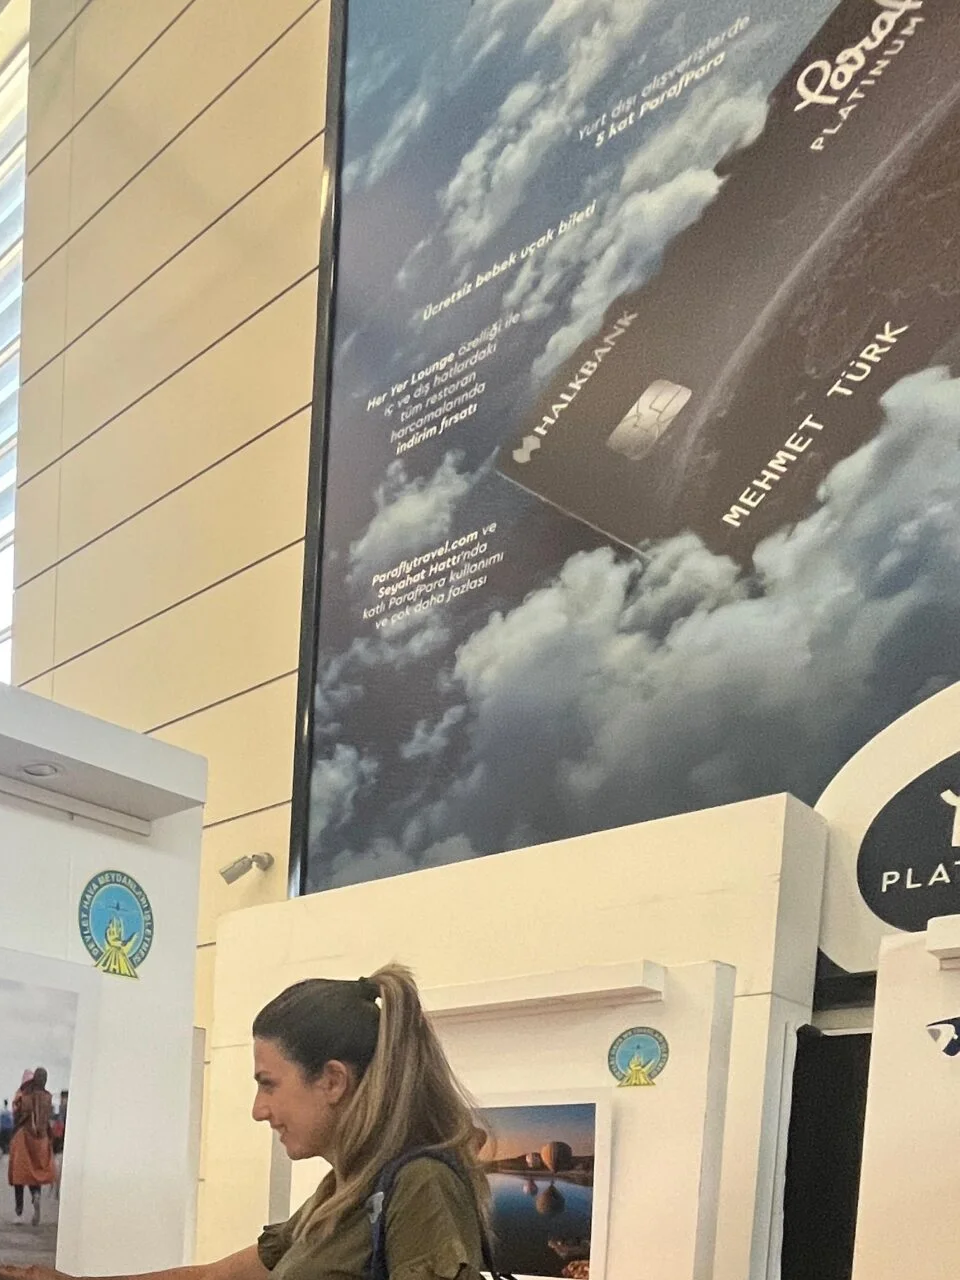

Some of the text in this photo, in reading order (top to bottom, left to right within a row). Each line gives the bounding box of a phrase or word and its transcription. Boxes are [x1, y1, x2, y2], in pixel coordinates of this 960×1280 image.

[810, 16, 925, 151] PLATINUM
[578, 112, 607, 141] Yurt
[595, 131, 605, 148] 5
[608, 111, 636, 139] kat
[422, 199, 597, 321] Ücretsiz bebek uçak bileti
[366, 391, 388, 412] Her
[390, 379, 409, 398] Yer
[410, 352, 455, 386] Lounge
[397, 394, 411, 408] ve
[433, 342, 497, 388] hatlardaki
[400, 371, 476, 422] tüm restoran
[534, 309, 639, 437] HALKBANK
[390, 381, 486, 443] harcamalarında
[396, 403, 478, 456] indirim fırsatı
[721, 320, 910, 528] MEHMET TÜRK
[371, 521, 497, 587] Paraflytravel.com ve
[377, 568, 426, 599] Seyahat
[362, 551, 505, 620] katlı ParafPara kullanımı
[375, 618, 388, 630] ve
[414, 593, 445, 614] daha
[447, 575, 488, 604] fazlası
[881, 859, 960, 893] PLA
